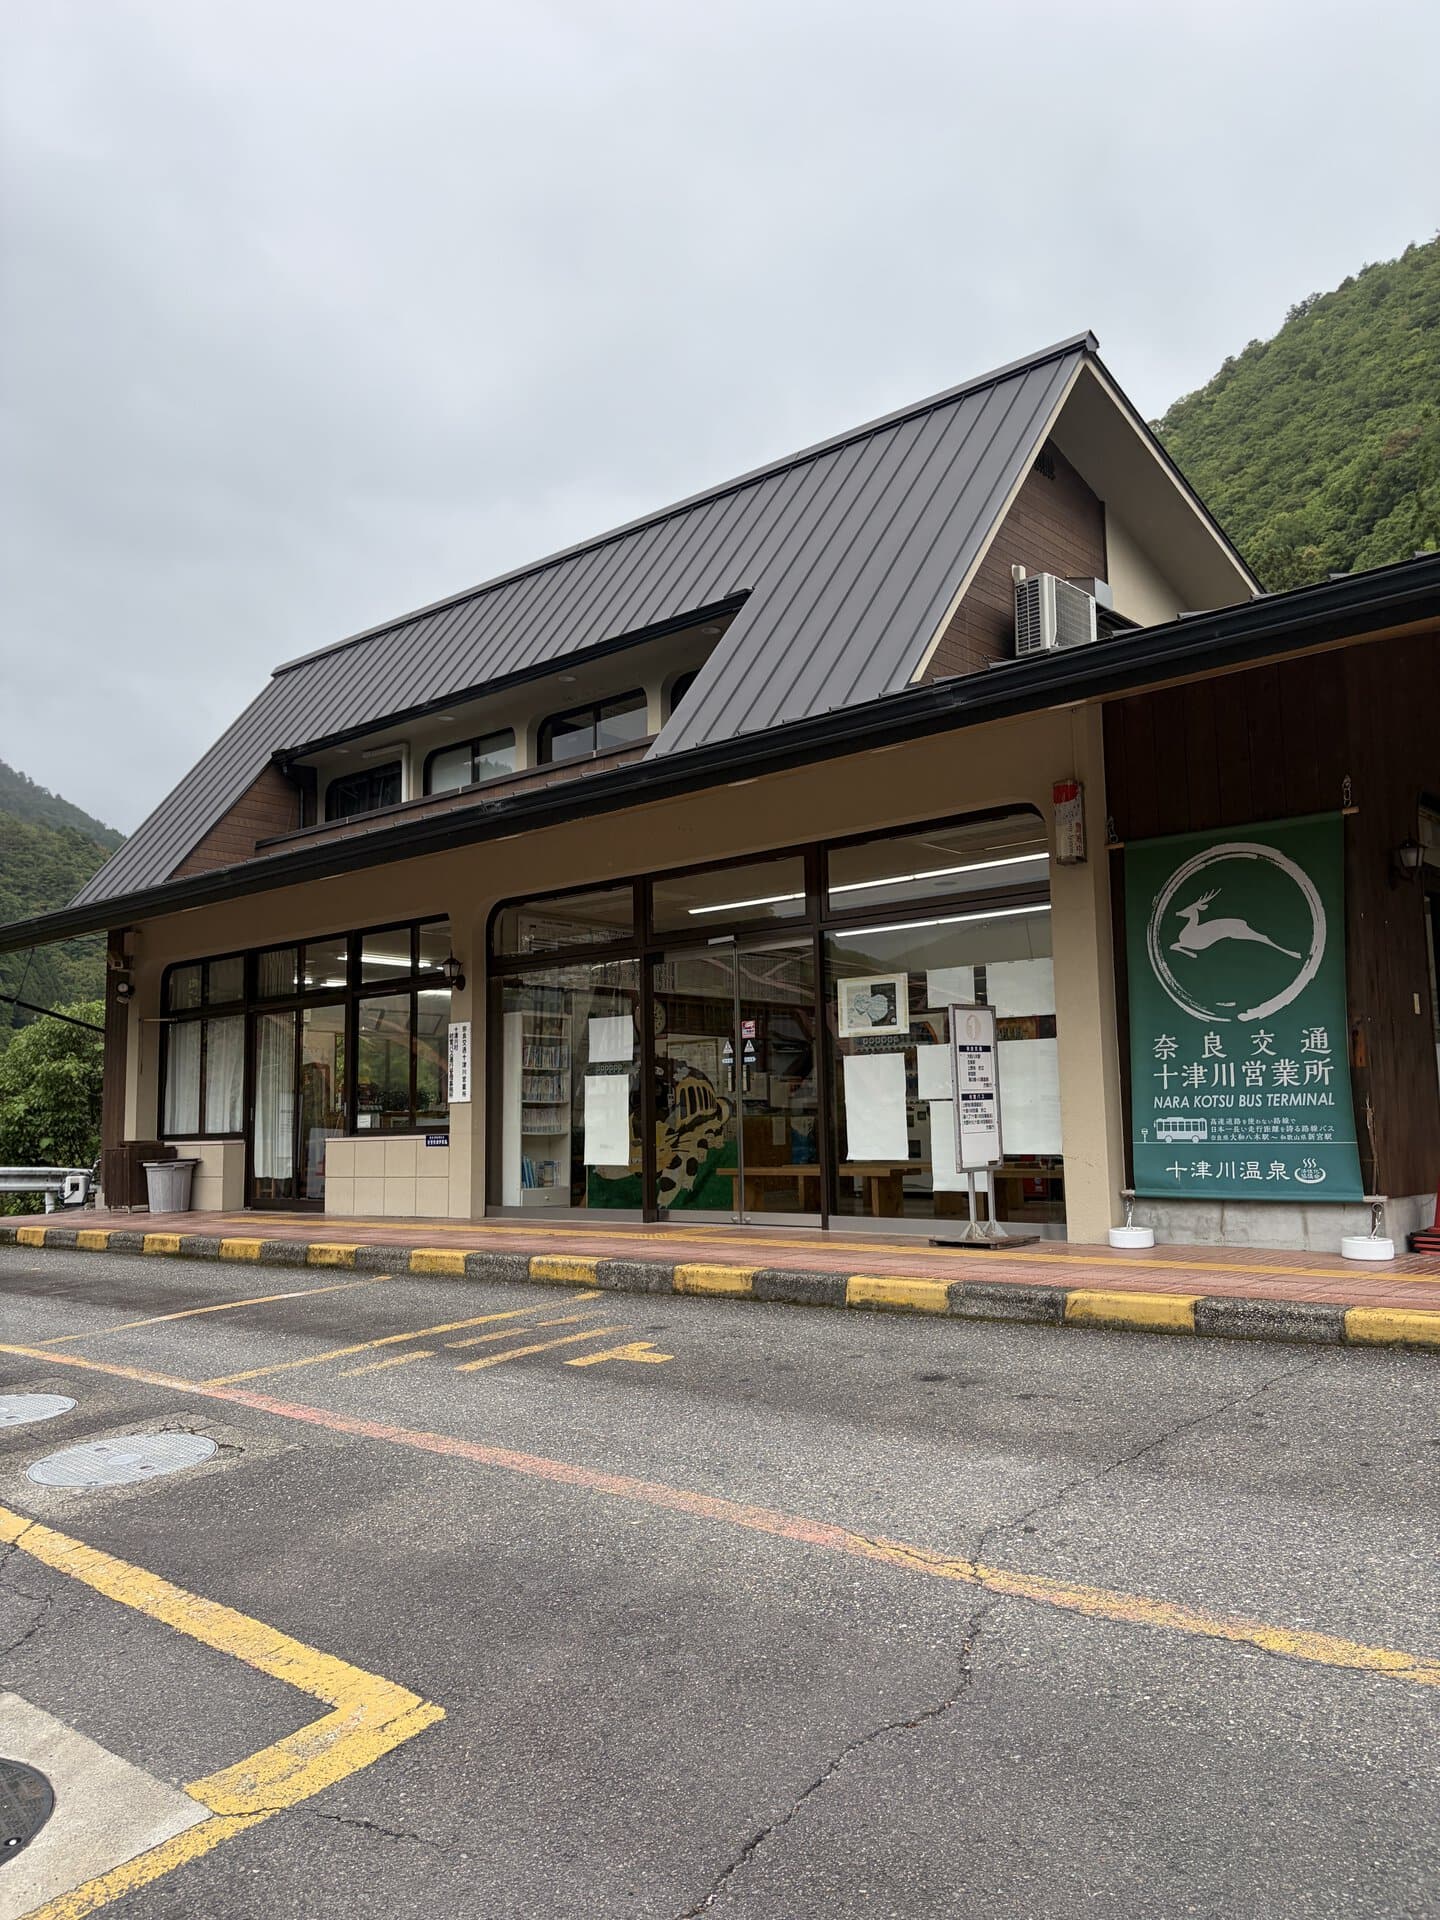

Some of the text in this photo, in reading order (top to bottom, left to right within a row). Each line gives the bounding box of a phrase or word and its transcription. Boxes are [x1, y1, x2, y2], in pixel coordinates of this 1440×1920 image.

[1152, 1026, 1332, 1061] 奈良交通
[1153, 1058, 1335, 1090] 十津川営業所
[1153, 1092, 1335, 1109] NARA KOTSU BUS TERMINAL
[1166, 1160, 1291, 1181] 十津川温泉
